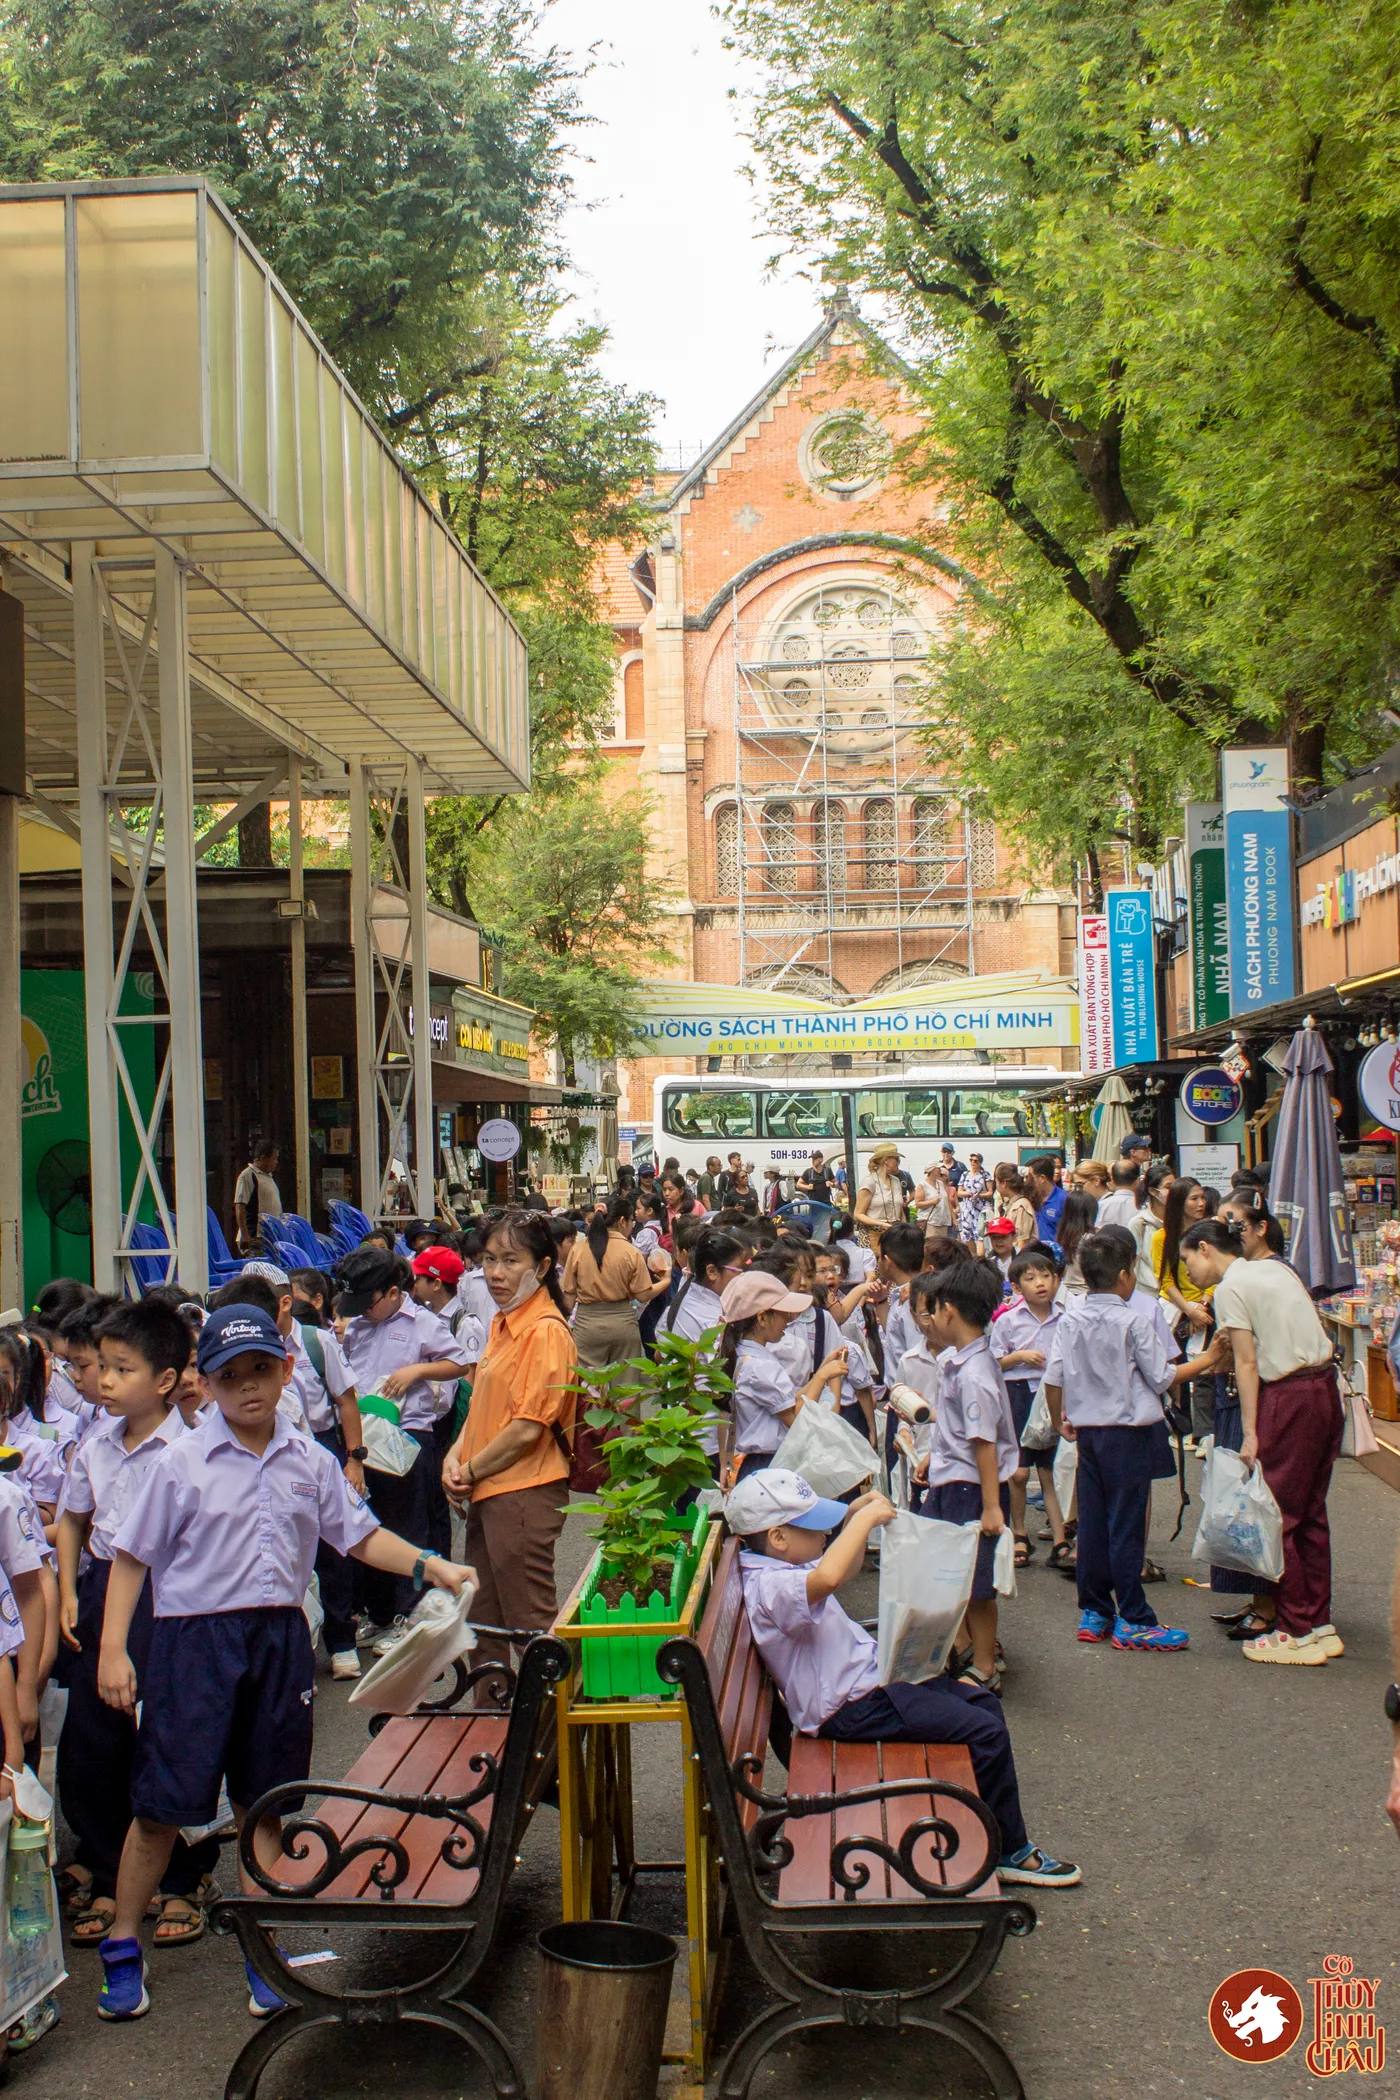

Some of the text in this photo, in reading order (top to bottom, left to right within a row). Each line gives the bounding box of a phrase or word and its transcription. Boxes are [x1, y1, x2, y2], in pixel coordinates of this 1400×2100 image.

[1243, 833, 1262, 1000] SÁCH PHƯƠNG NAM
[1264, 847, 1280, 985] PHUONG NAM BOOK
[1209, 902, 1231, 994] NHÃ NAM
[1100, 954, 1109, 979] MINH
[1136, 959, 1145, 982] HOUSE
[1119, 968, 1135, 993] BẢN
[1121, 997, 1136, 1026] XUẤT
[1137, 983, 1147, 1026] PUBLISHING
[632, 1009, 1053, 1038] ĐƯỜNG SÁCH THÀNH PHỐ HỒ CHÍ MINH
[779, 1040, 813, 1050] MINH
[824, 1039, 857, 1048] CITY
[868, 1037, 902, 1047] BOOK
[914, 1036, 967, 1046] STREET
[1101, 1037, 1112, 1069] THÀNH
[1123, 1029, 1137, 1055] NHÀ
[1087, 1049, 1098, 1070] NHÀ
[1192, 1100, 1232, 1109] STORE
[1193, 1087, 1231, 1100] BOOK
